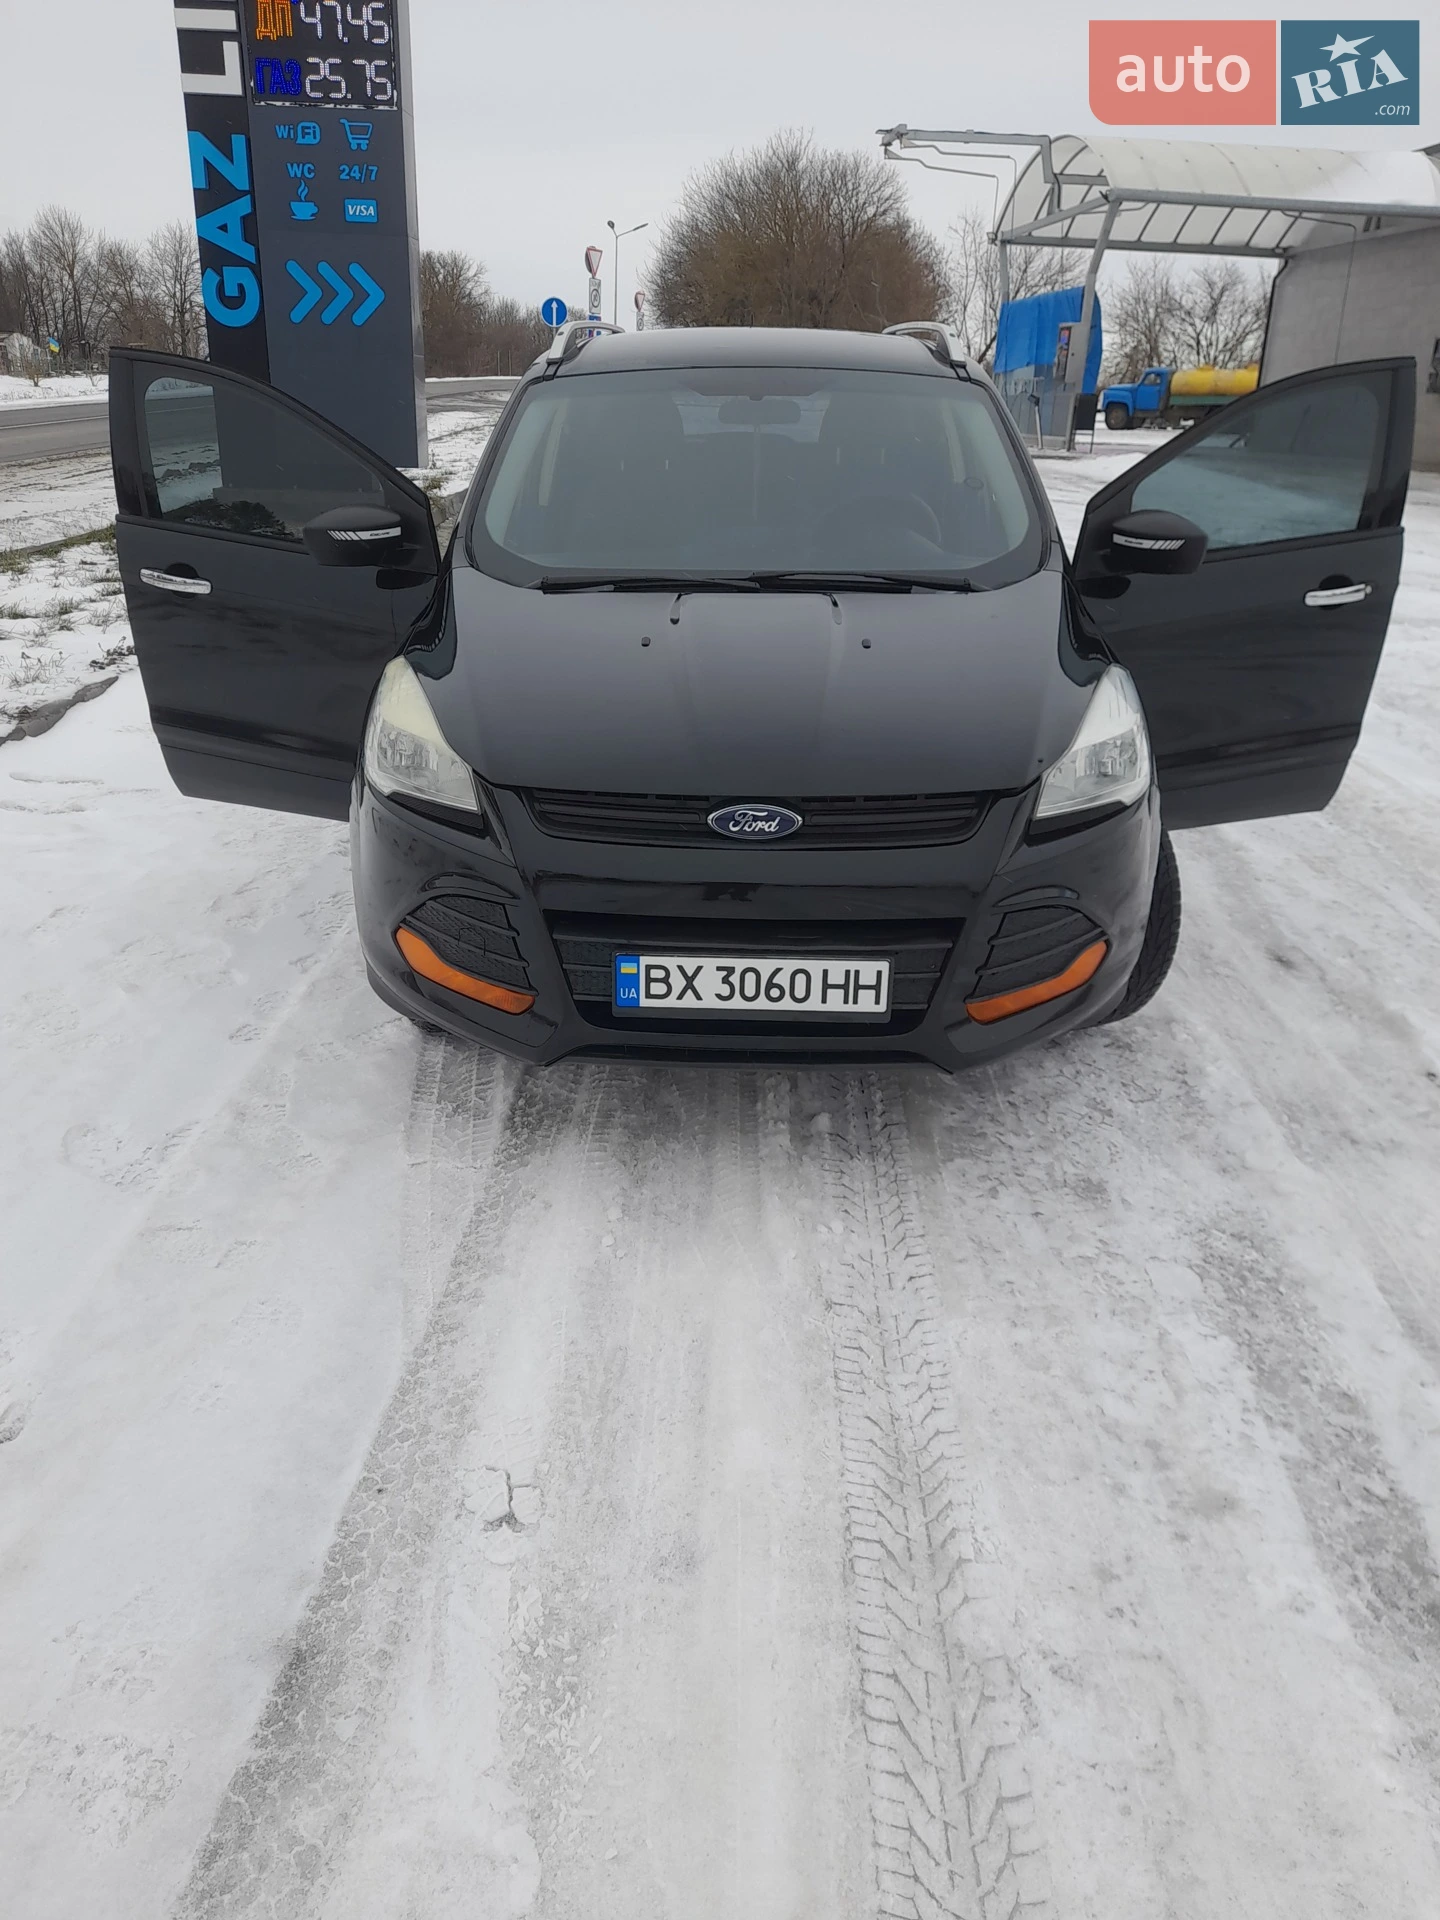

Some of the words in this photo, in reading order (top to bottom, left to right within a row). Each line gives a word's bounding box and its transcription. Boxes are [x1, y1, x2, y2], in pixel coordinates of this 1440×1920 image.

[300, 0, 389, 44] 47.45
[174, 0, 243, 96] LI
[255, 57, 301, 95] ГАЗ
[305, 57, 393, 100] 25.75
[286, 162, 316, 179] WC
[339, 163, 379, 184] 24/7
[347, 204, 376, 217] VISA
[188, 131, 261, 328] GAZ
[728, 810, 781, 832] Ford
[620, 987, 638, 999] UA
[644, 964, 705, 1001] BX
[714, 966, 812, 1004] 3060
[820, 968, 883, 1006] HH
